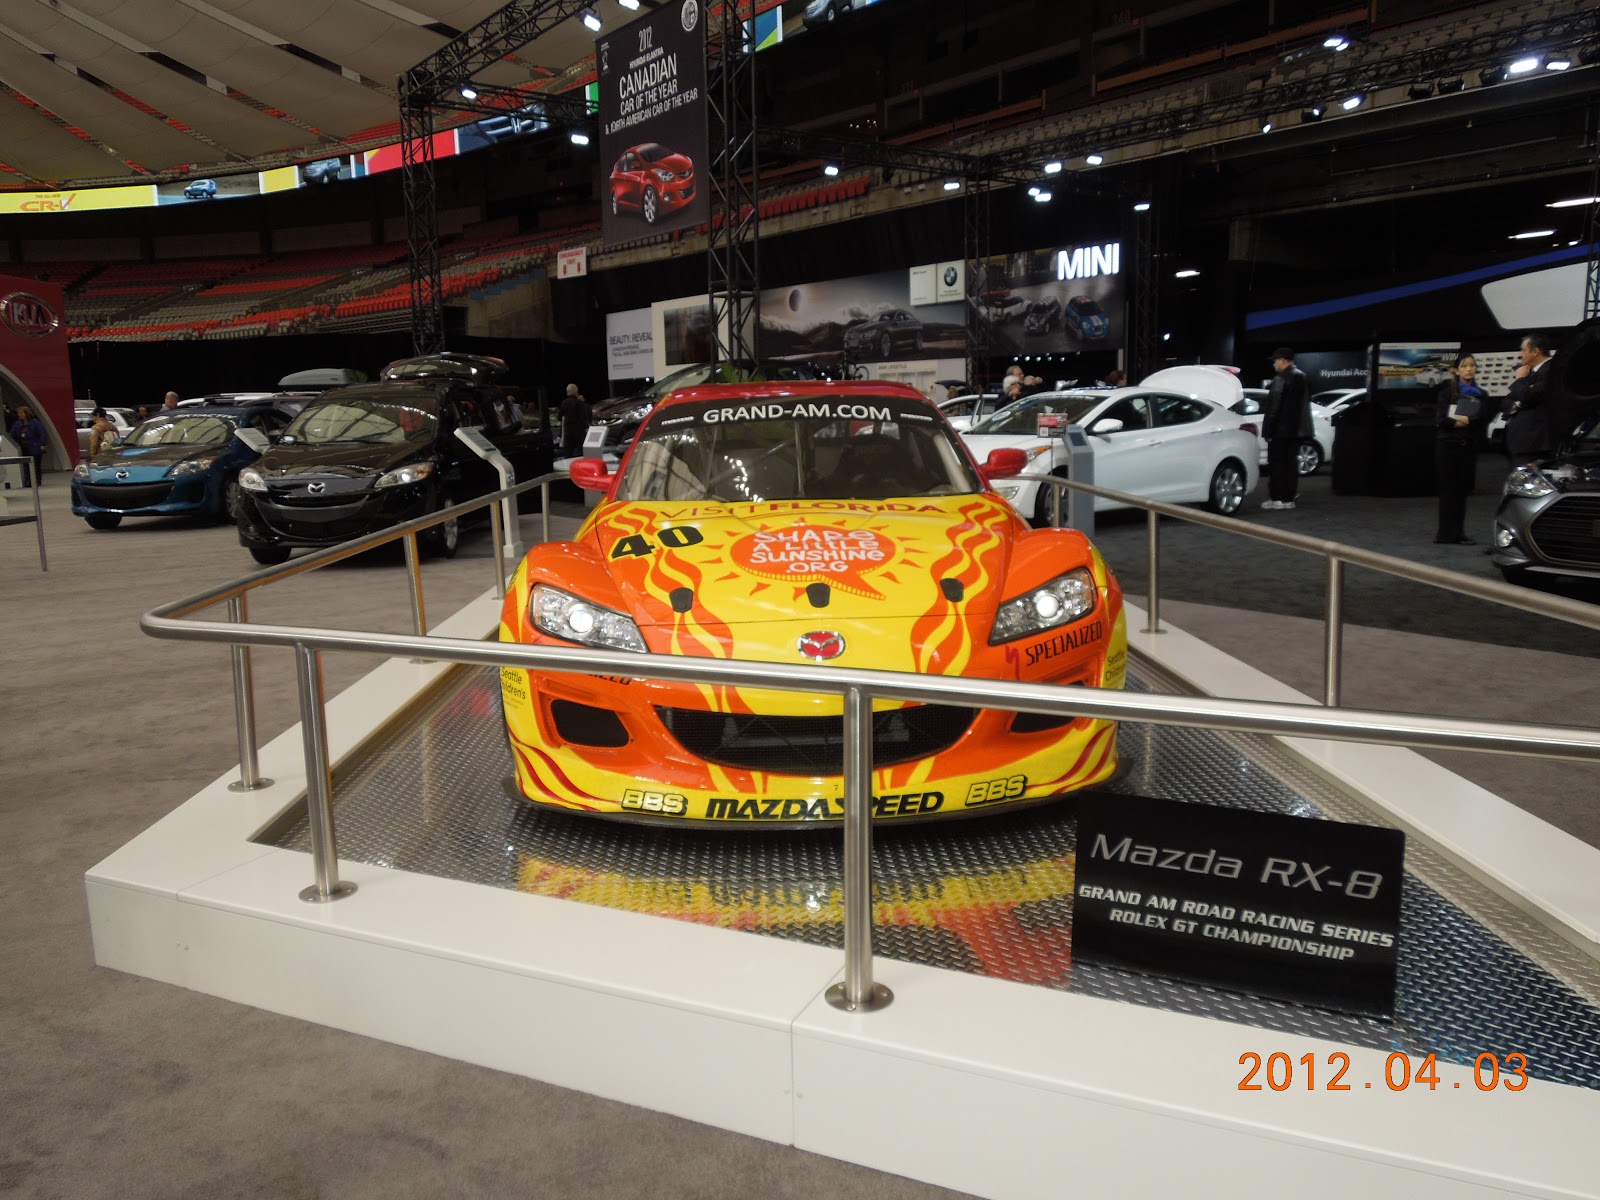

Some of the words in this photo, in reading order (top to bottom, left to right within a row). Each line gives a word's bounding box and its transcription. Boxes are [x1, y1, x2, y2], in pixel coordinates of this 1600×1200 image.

[638, 25, 653, 52] 2012
[619, 52, 677, 99] CANADIAN
[620, 97, 635, 116] CAR
[635, 93, 644, 110] OF
[644, 87, 658, 105] THE
[658, 78, 678, 99] YEAR
[625, 105, 652, 127] AMERICAN
[652, 102, 663, 117] CAR
[663, 98, 672, 112] OF
[671, 93, 682, 109] THE
[682, 87, 698, 104] YEAR
[19, 193, 77, 212] CR-V
[1057, 242, 1120, 280] MINI
[13, 302, 47, 327] KIA
[1321, 368, 1353, 379] Hyundai
[703, 404, 892, 423] GRAND-AM.COM
[610, 525, 705, 560] 40
[753, 529, 876, 543] SHARE
[753, 541, 771, 552] A
[785, 540, 880, 551] LITTLE
[750, 550, 885, 563] SUNSHINE
[1025, 621, 1103, 667] SPECIALIZED
[501, 666, 522, 685] Seattle
[621, 789, 688, 816] BBS
[965, 774, 1029, 807] BBS
[705, 791, 945, 820] MAZDAEED
[1089, 833, 1244, 879] Mazda
[1259, 856, 1384, 900] RX-8
[1078, 884, 1142, 906] GRAND
[1145, 894, 1177, 912] AM
[1183, 900, 1237, 921] ROAD
[1240, 909, 1315, 935] RACING
[1321, 922, 1395, 948] SERIES
[1109, 908, 1169, 930] ROLEX
[1173, 917, 1198, 934] GT
[1203, 922, 1356, 962] CHAMPIONSHIP
